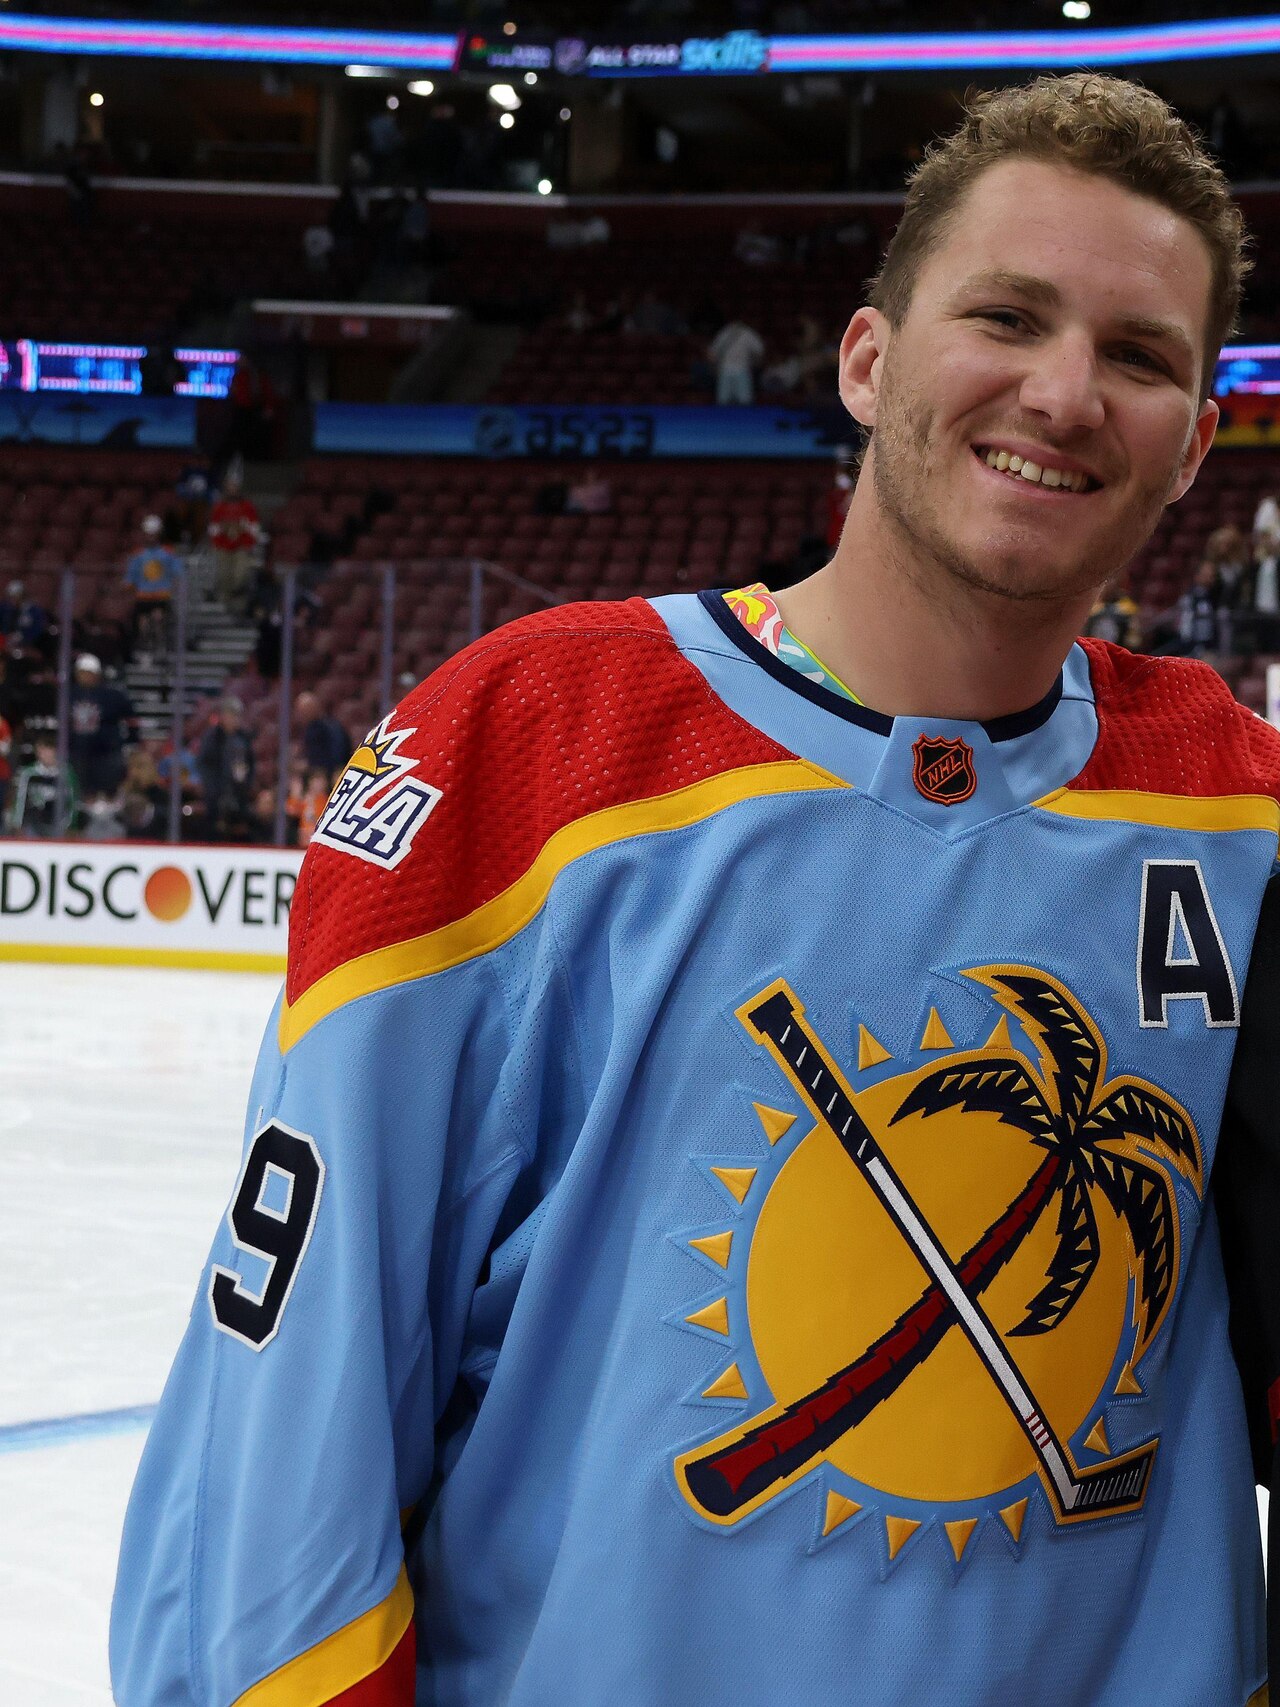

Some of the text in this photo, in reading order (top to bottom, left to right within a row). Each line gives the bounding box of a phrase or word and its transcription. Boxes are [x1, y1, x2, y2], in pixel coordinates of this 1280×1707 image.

[312, 768, 436, 863] FLA
[927, 755, 962, 788] NHL
[1, 860, 299, 926] DISCOVER
[1136, 859, 1241, 1029] A
[207, 1110, 327, 1353] 9
